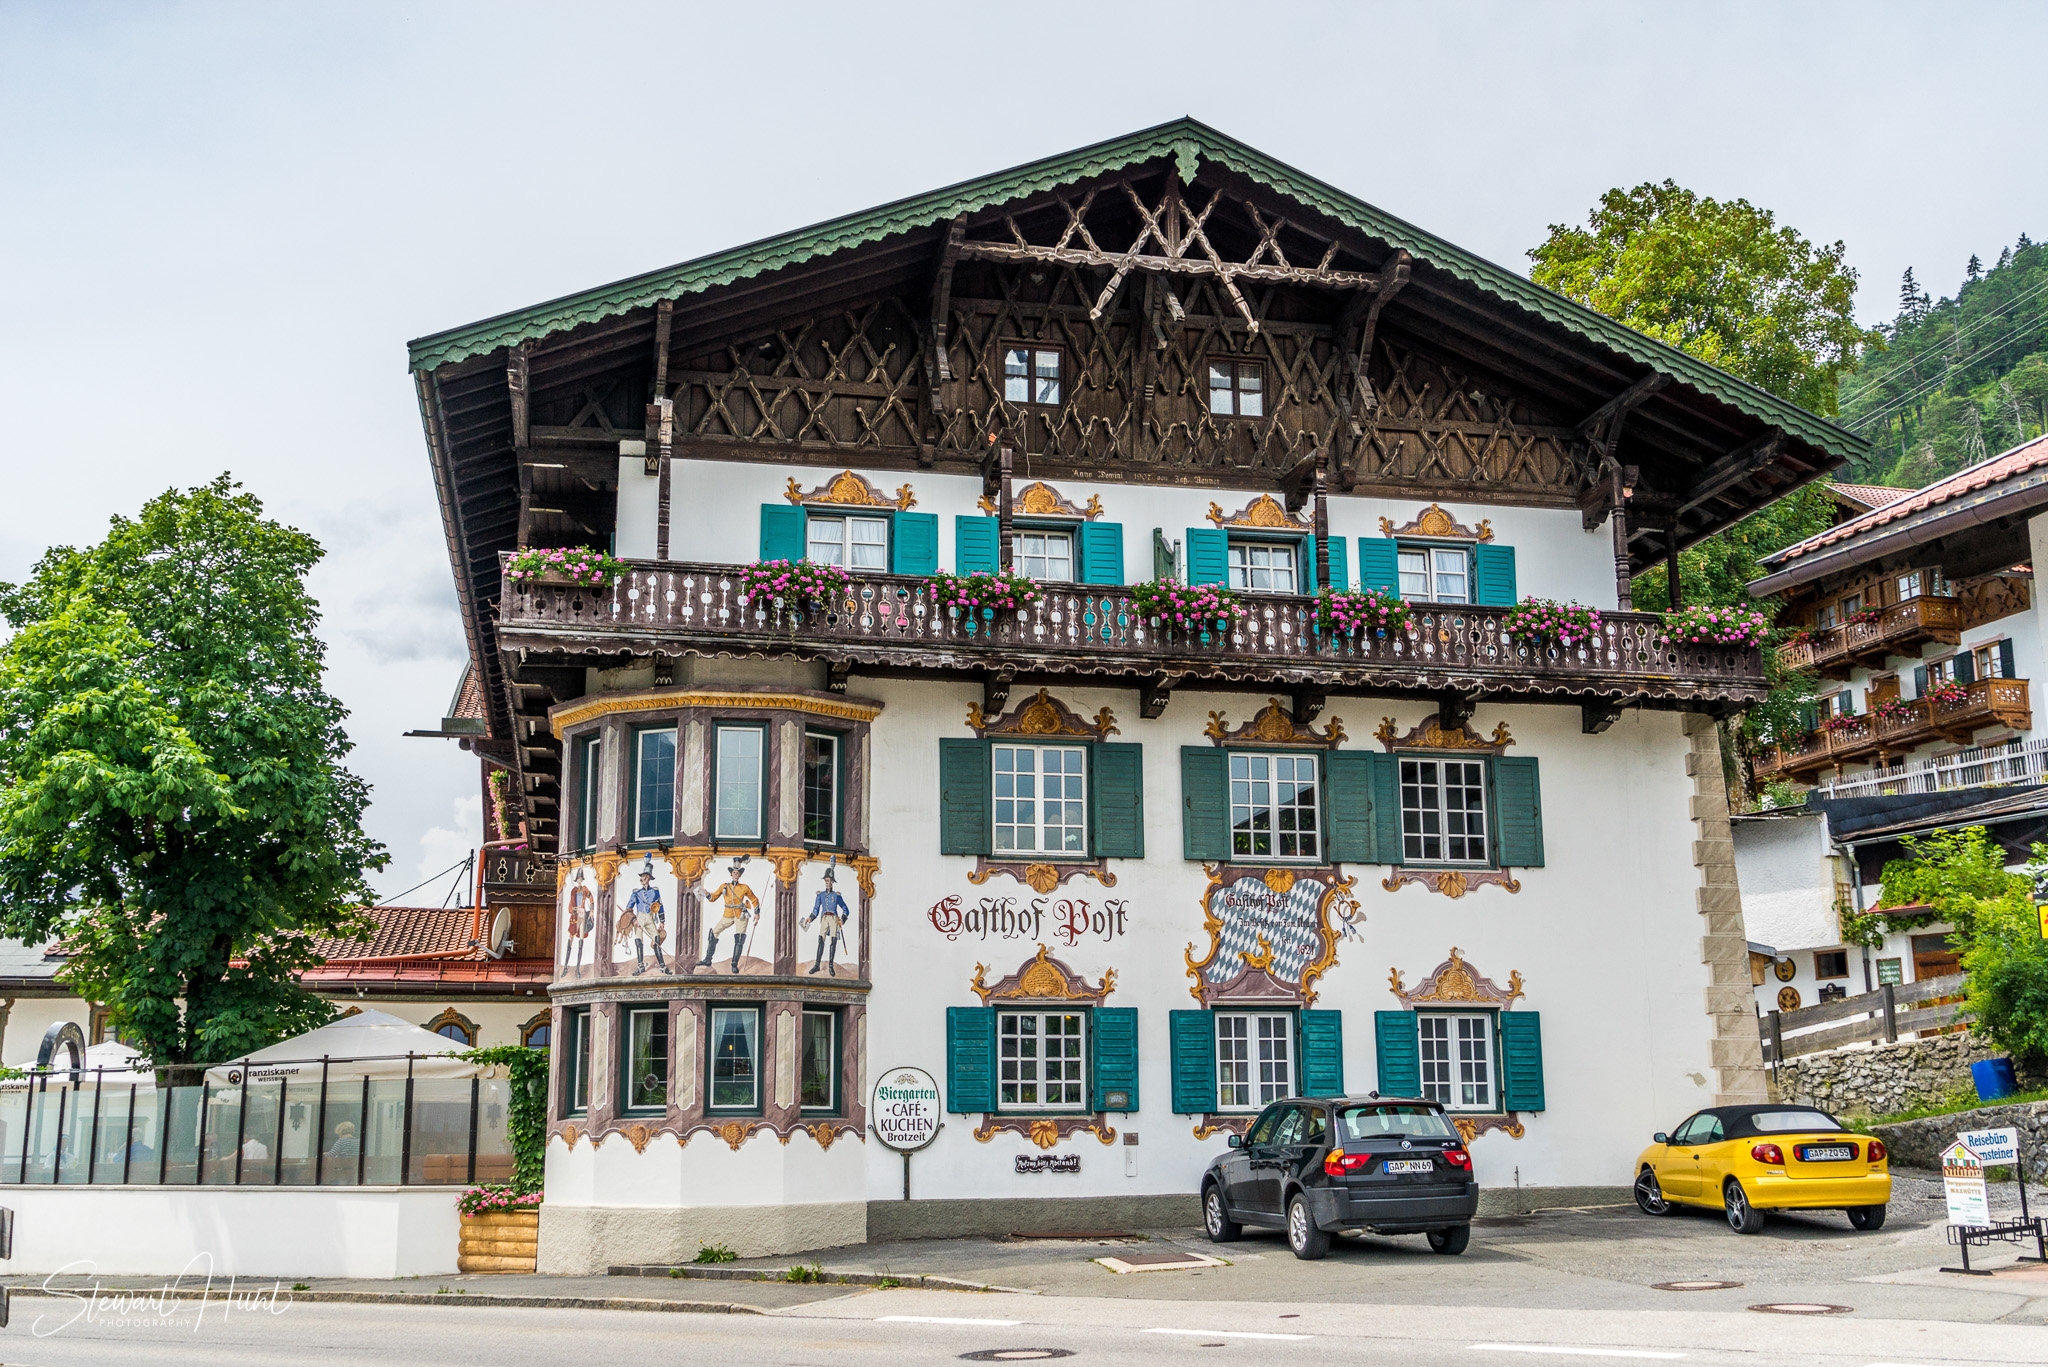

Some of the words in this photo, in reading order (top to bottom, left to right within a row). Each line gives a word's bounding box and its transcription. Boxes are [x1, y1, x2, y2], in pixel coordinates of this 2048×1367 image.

[248, 1068, 300, 1077] ranziskaner
[878, 1086, 936, 1103] Biergarten
[880, 1118, 933, 1132] KUCHEN
[887, 1132, 926, 1142] Brotzeit
[1967, 1132, 2008, 1148] Reisebüro
[1808, 1149, 1824, 1158] GAP
[1389, 1162, 1405, 1171] GAP
